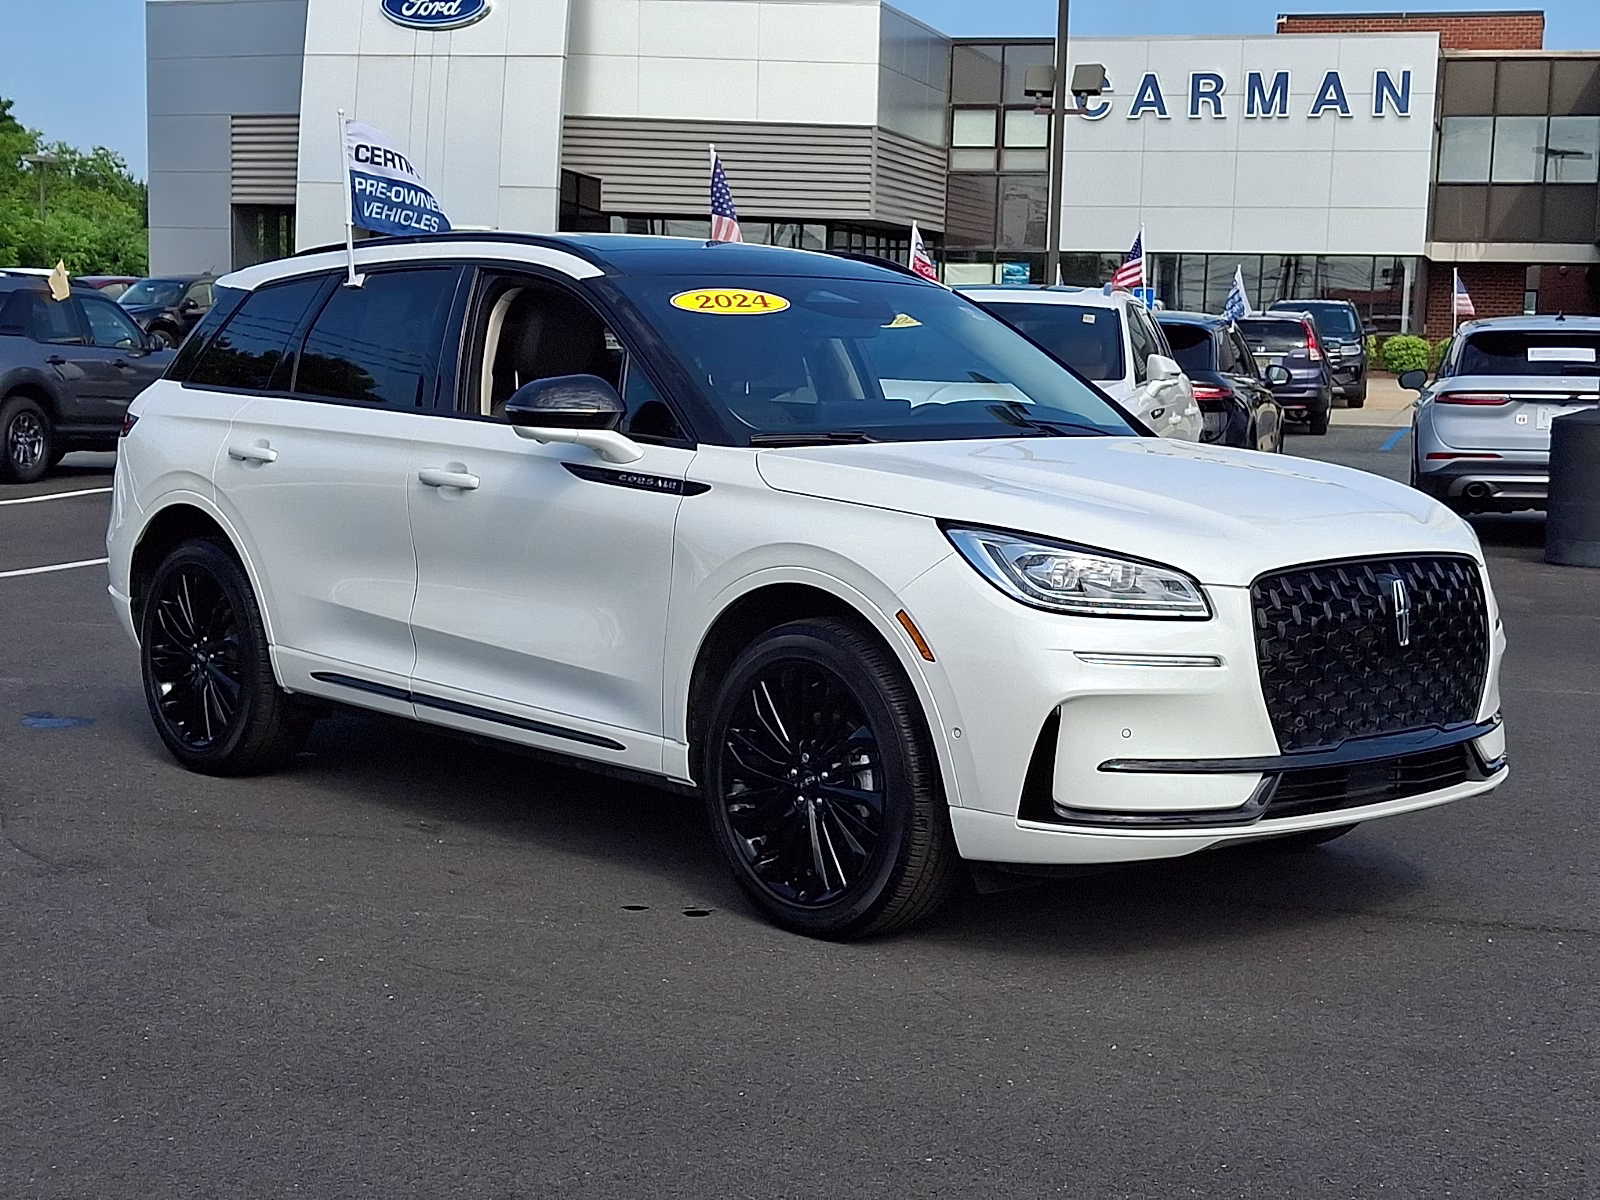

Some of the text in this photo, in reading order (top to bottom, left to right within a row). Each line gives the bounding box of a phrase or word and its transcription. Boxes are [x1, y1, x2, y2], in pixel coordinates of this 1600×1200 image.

[401, 0, 462, 17] Ford
[354, 177, 440, 213] PRE-OWNE
[363, 200, 440, 233] VEHICLES
[695, 294, 771, 309] 2024
